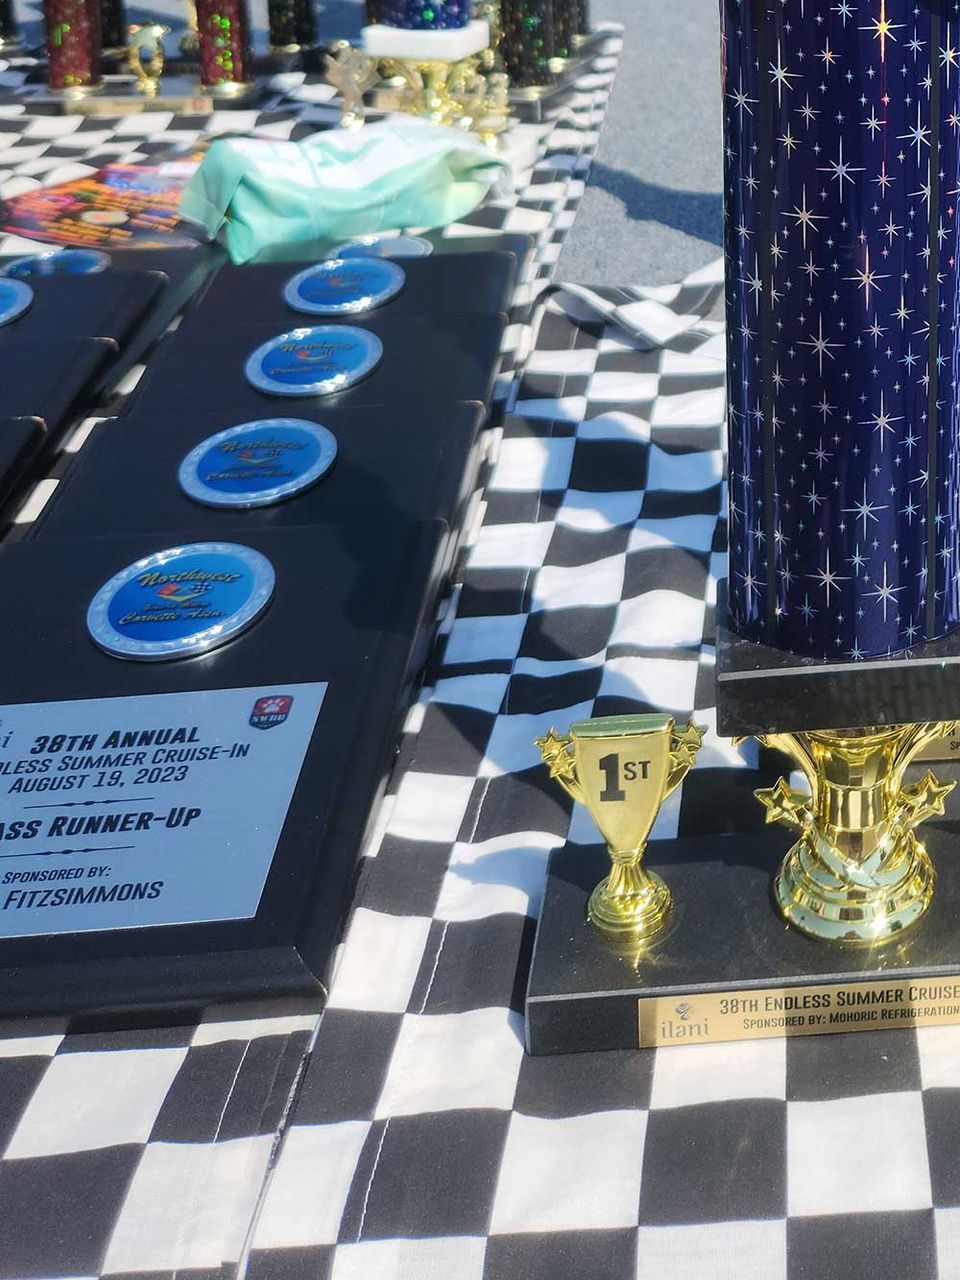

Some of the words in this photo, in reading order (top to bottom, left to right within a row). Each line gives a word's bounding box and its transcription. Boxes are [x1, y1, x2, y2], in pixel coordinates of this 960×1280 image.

[137, 569, 242, 587] Northwest
[118, 611, 179, 625] Corvette
[30, 734, 99, 755] 38TH
[101, 727, 200, 749] ANNUAL
[57, 752, 147, 771] SUMMER
[152, 743, 251, 764] CRUISE-IN
[8, 774, 90, 794] AUGUST
[92, 770, 125, 788] 19,
[133, 765, 189, 785] 2023
[599, 753, 651, 802] 1ST
[47, 806, 202, 838] RUNNER-UP
[2, 868, 83, 884] SPONSORED
[87, 865, 112, 878] BY:
[2, 881, 164, 910] FITZSIMMONS
[720, 997, 758, 1015] 38TH
[765, 993, 830, 1012] ENDLESS
[837, 988, 904, 1007] SUMMER
[661, 1019, 710, 1039] ilani
[743, 1015, 805, 1030] SPONSORED
[809, 1014, 826, 1025] BY:
[829, 1008, 878, 1024] MOHORIC
[881, 1005, 960, 1019] REFRIGERATION
